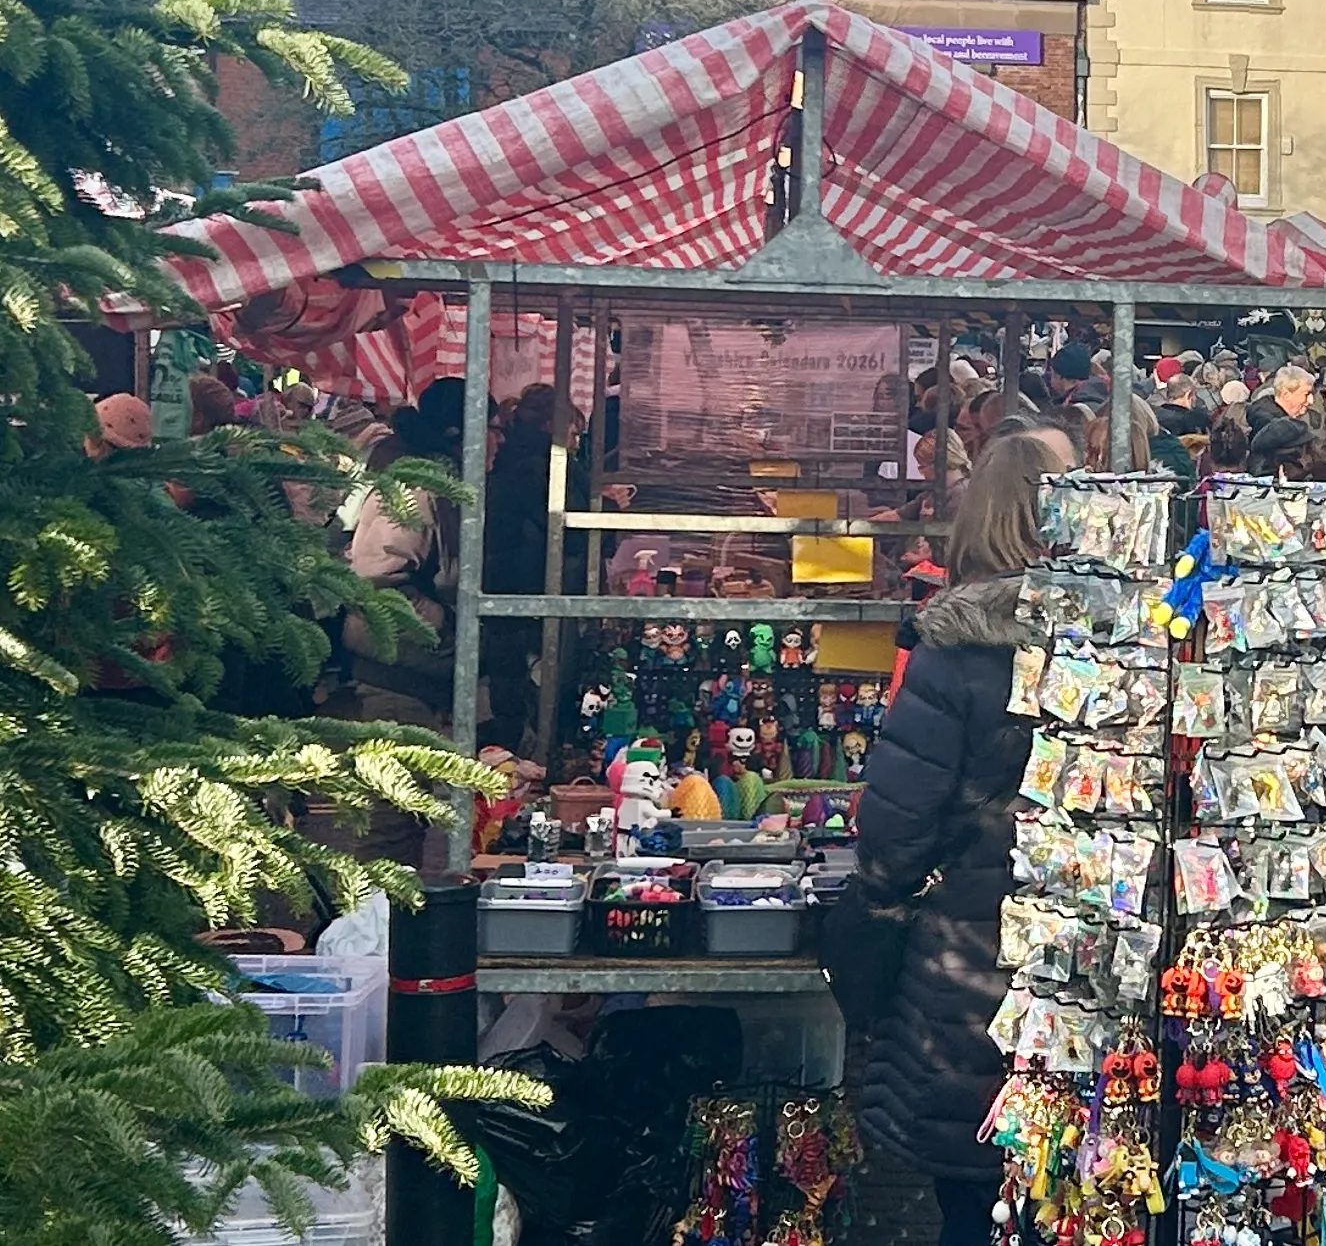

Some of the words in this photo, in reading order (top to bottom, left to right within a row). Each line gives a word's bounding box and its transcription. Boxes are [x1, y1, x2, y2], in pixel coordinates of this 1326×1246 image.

[946, 36, 975, 48] people
[977, 35, 992, 45] live
[995, 36, 1014, 46] with
[971, 49, 1028, 61] bereavement
